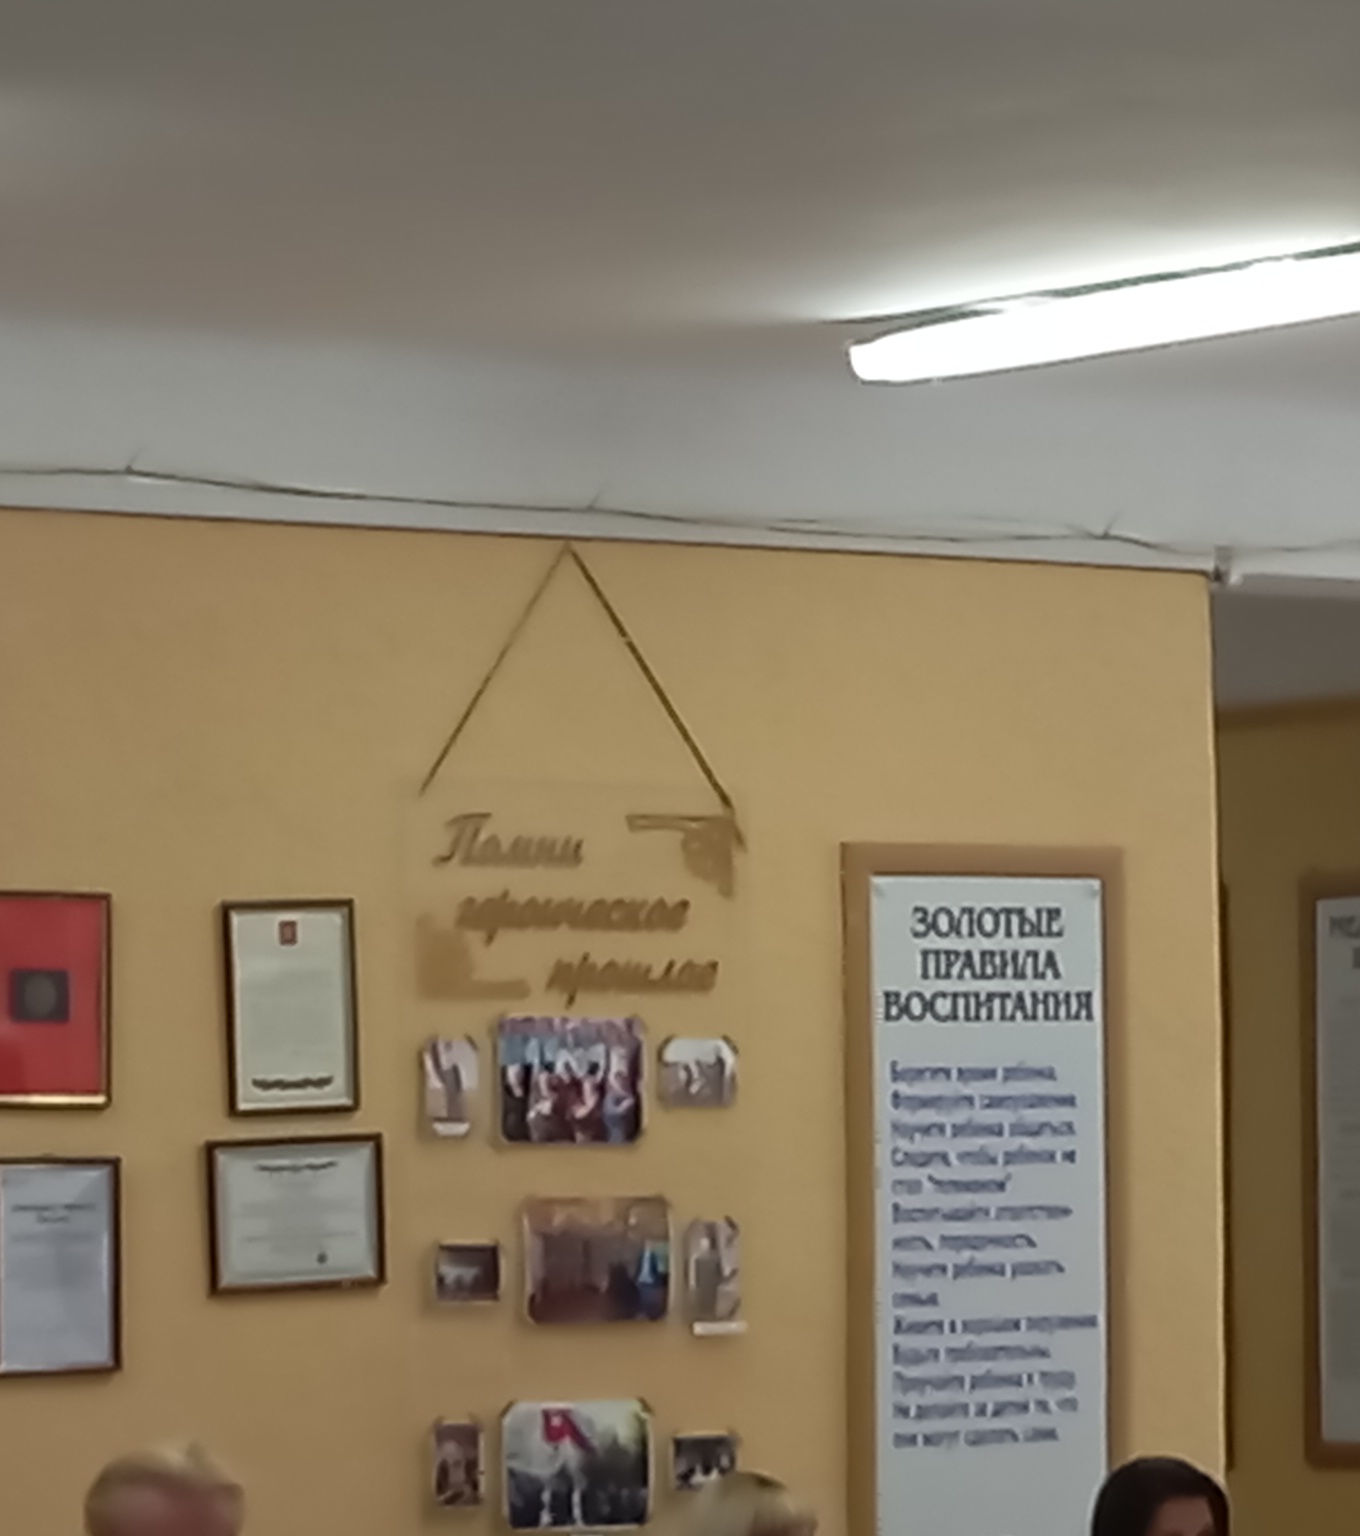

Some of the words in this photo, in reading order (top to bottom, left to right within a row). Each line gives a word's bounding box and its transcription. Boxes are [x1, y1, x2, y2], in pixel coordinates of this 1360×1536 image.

[432, 812, 584, 869] Помни
[911, 906, 1064, 939] ЗОЛОТЫЕ
[920, 949, 1061, 980] ПРАВИЛА
[883, 990, 1094, 1022] ВОСПИТАНИЯ
